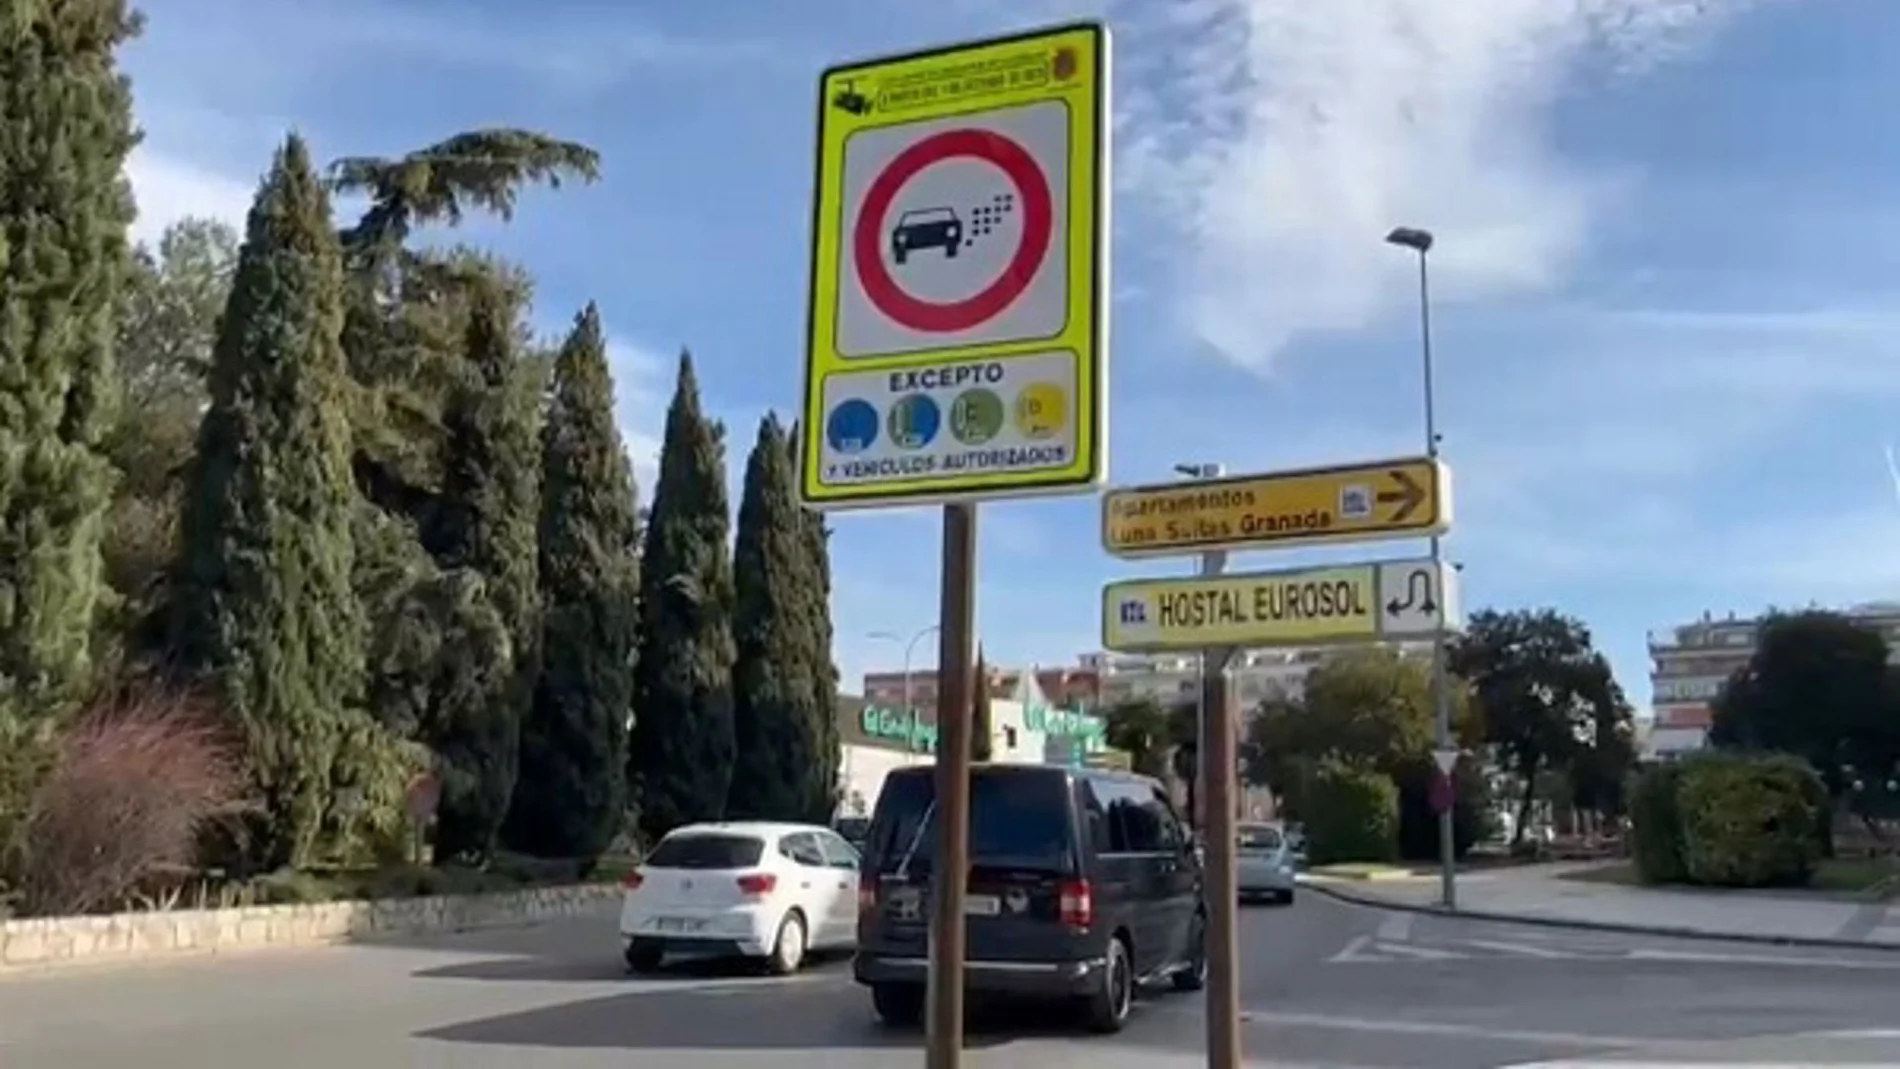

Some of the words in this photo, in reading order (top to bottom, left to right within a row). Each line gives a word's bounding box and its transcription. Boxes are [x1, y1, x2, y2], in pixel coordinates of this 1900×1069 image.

[889, 363, 1004, 392] EXCEPTO
[943, 446, 1065, 470] AUTORIZADOS
[1241, 508, 1331, 533] Granada
[1158, 588, 1248, 627] HOSTAL
[1253, 580, 1367, 622] EUROSOL
